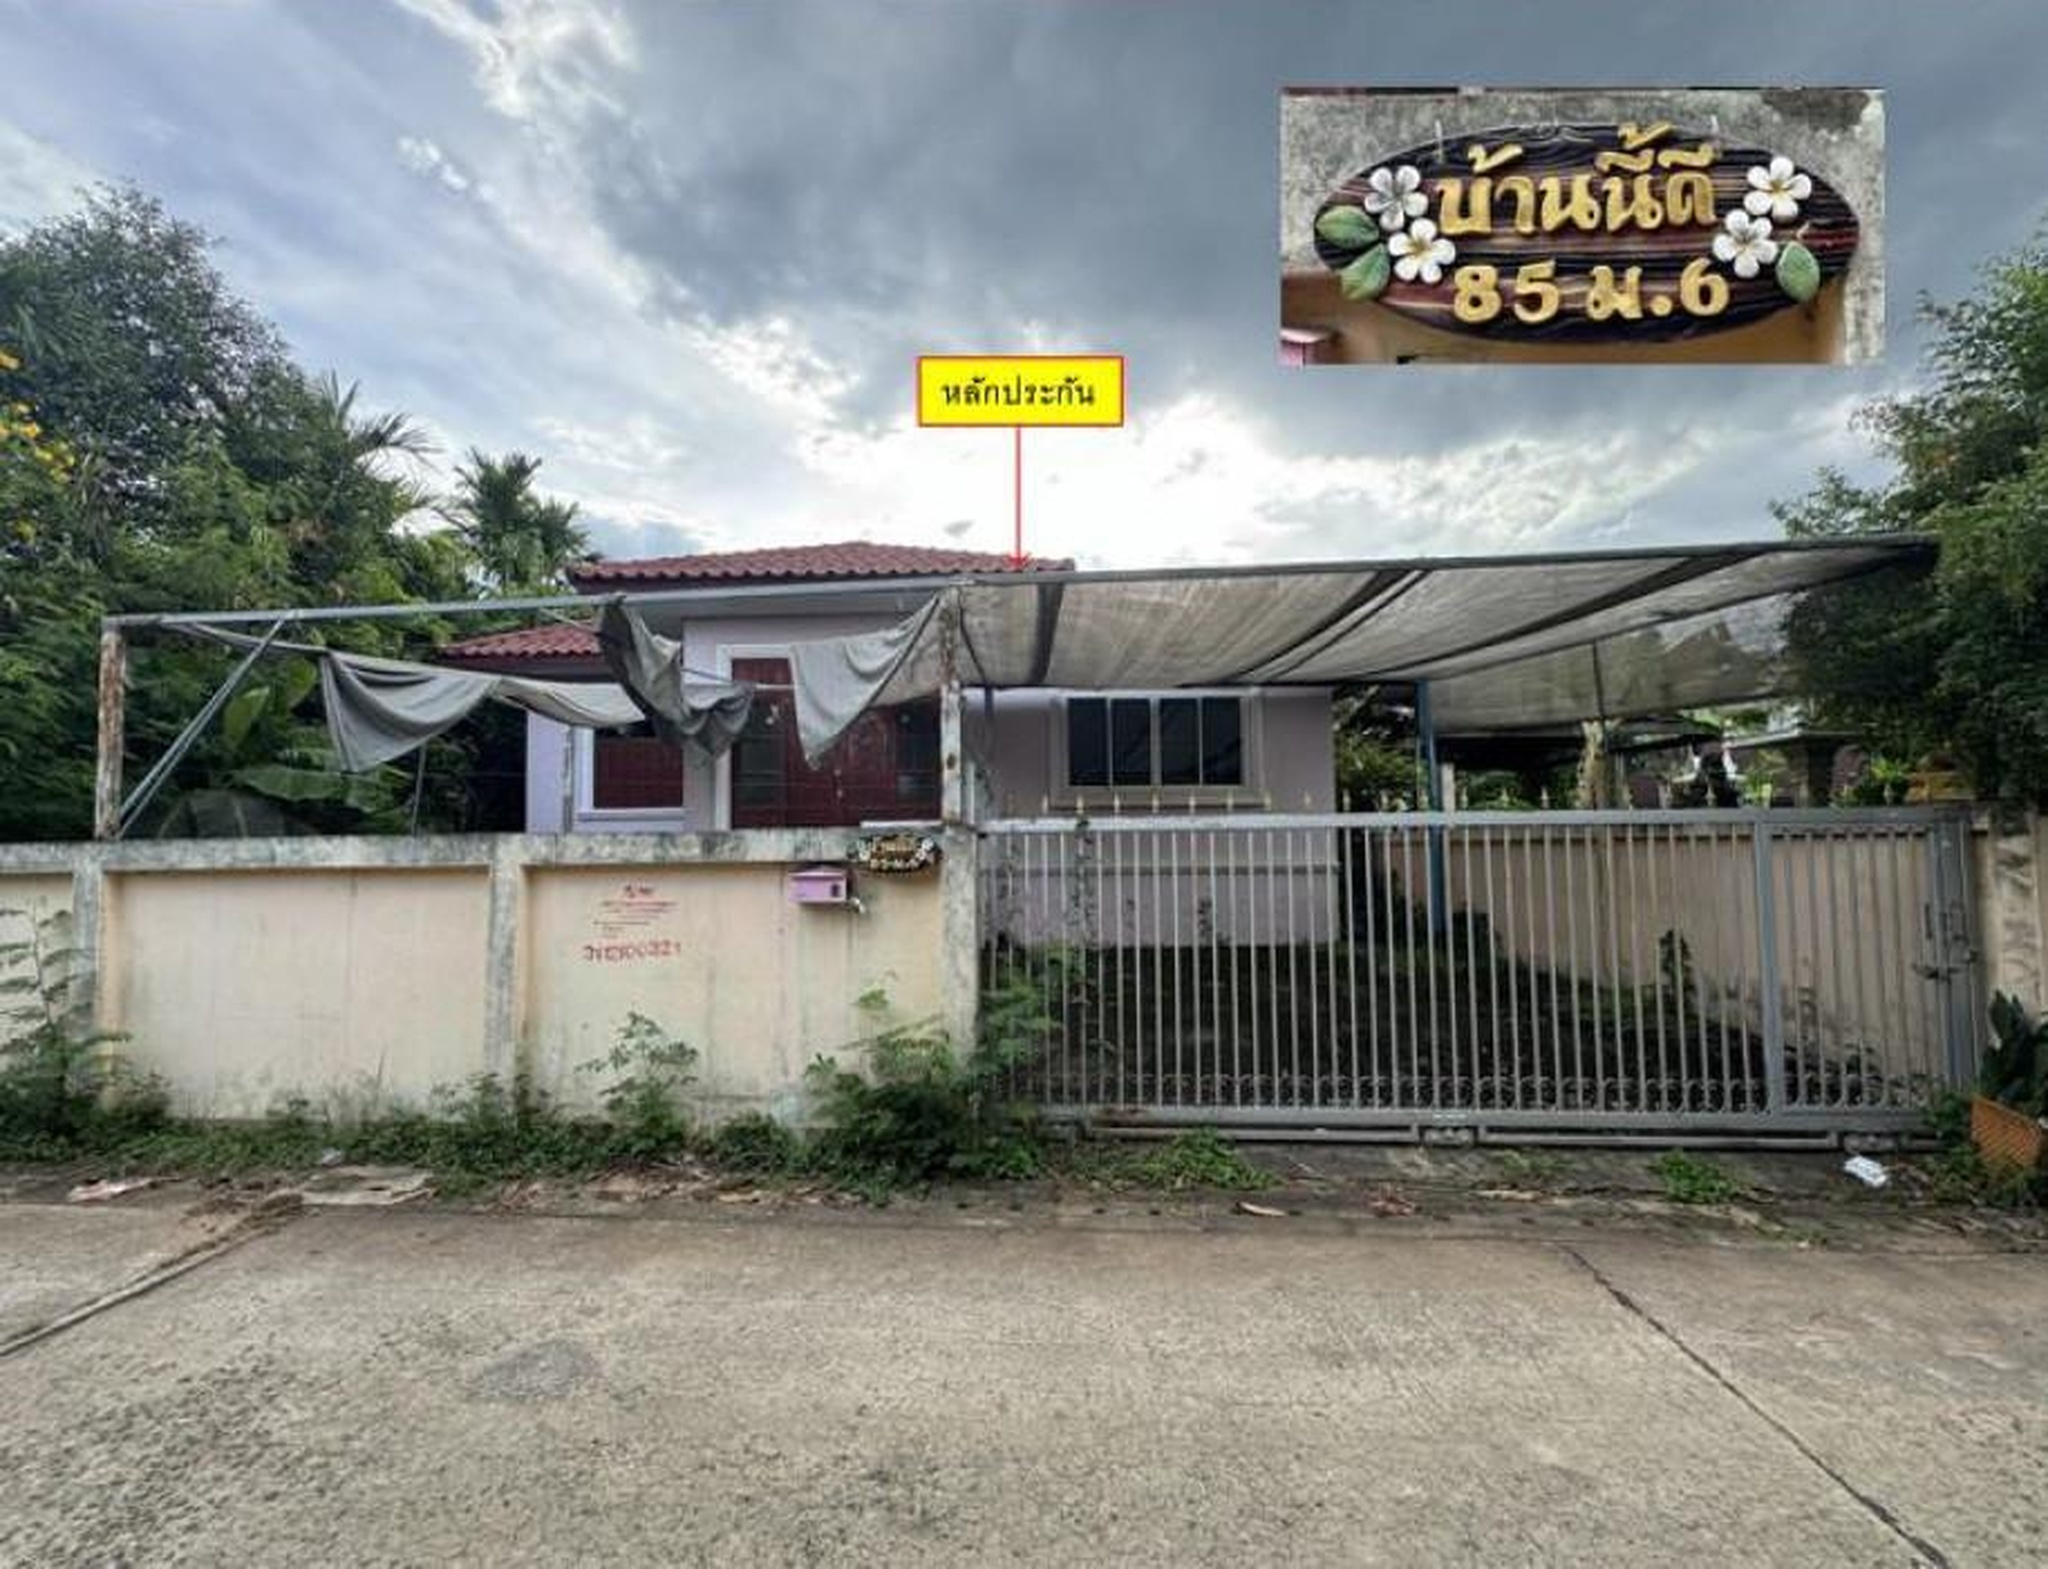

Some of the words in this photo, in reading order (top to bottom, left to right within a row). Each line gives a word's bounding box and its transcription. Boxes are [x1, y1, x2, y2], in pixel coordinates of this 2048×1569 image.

[1435, 121, 1720, 236] บ้านนี้ดี
[1452, 259, 1561, 324] 85
[1585, 256, 1731, 321] ม.6
